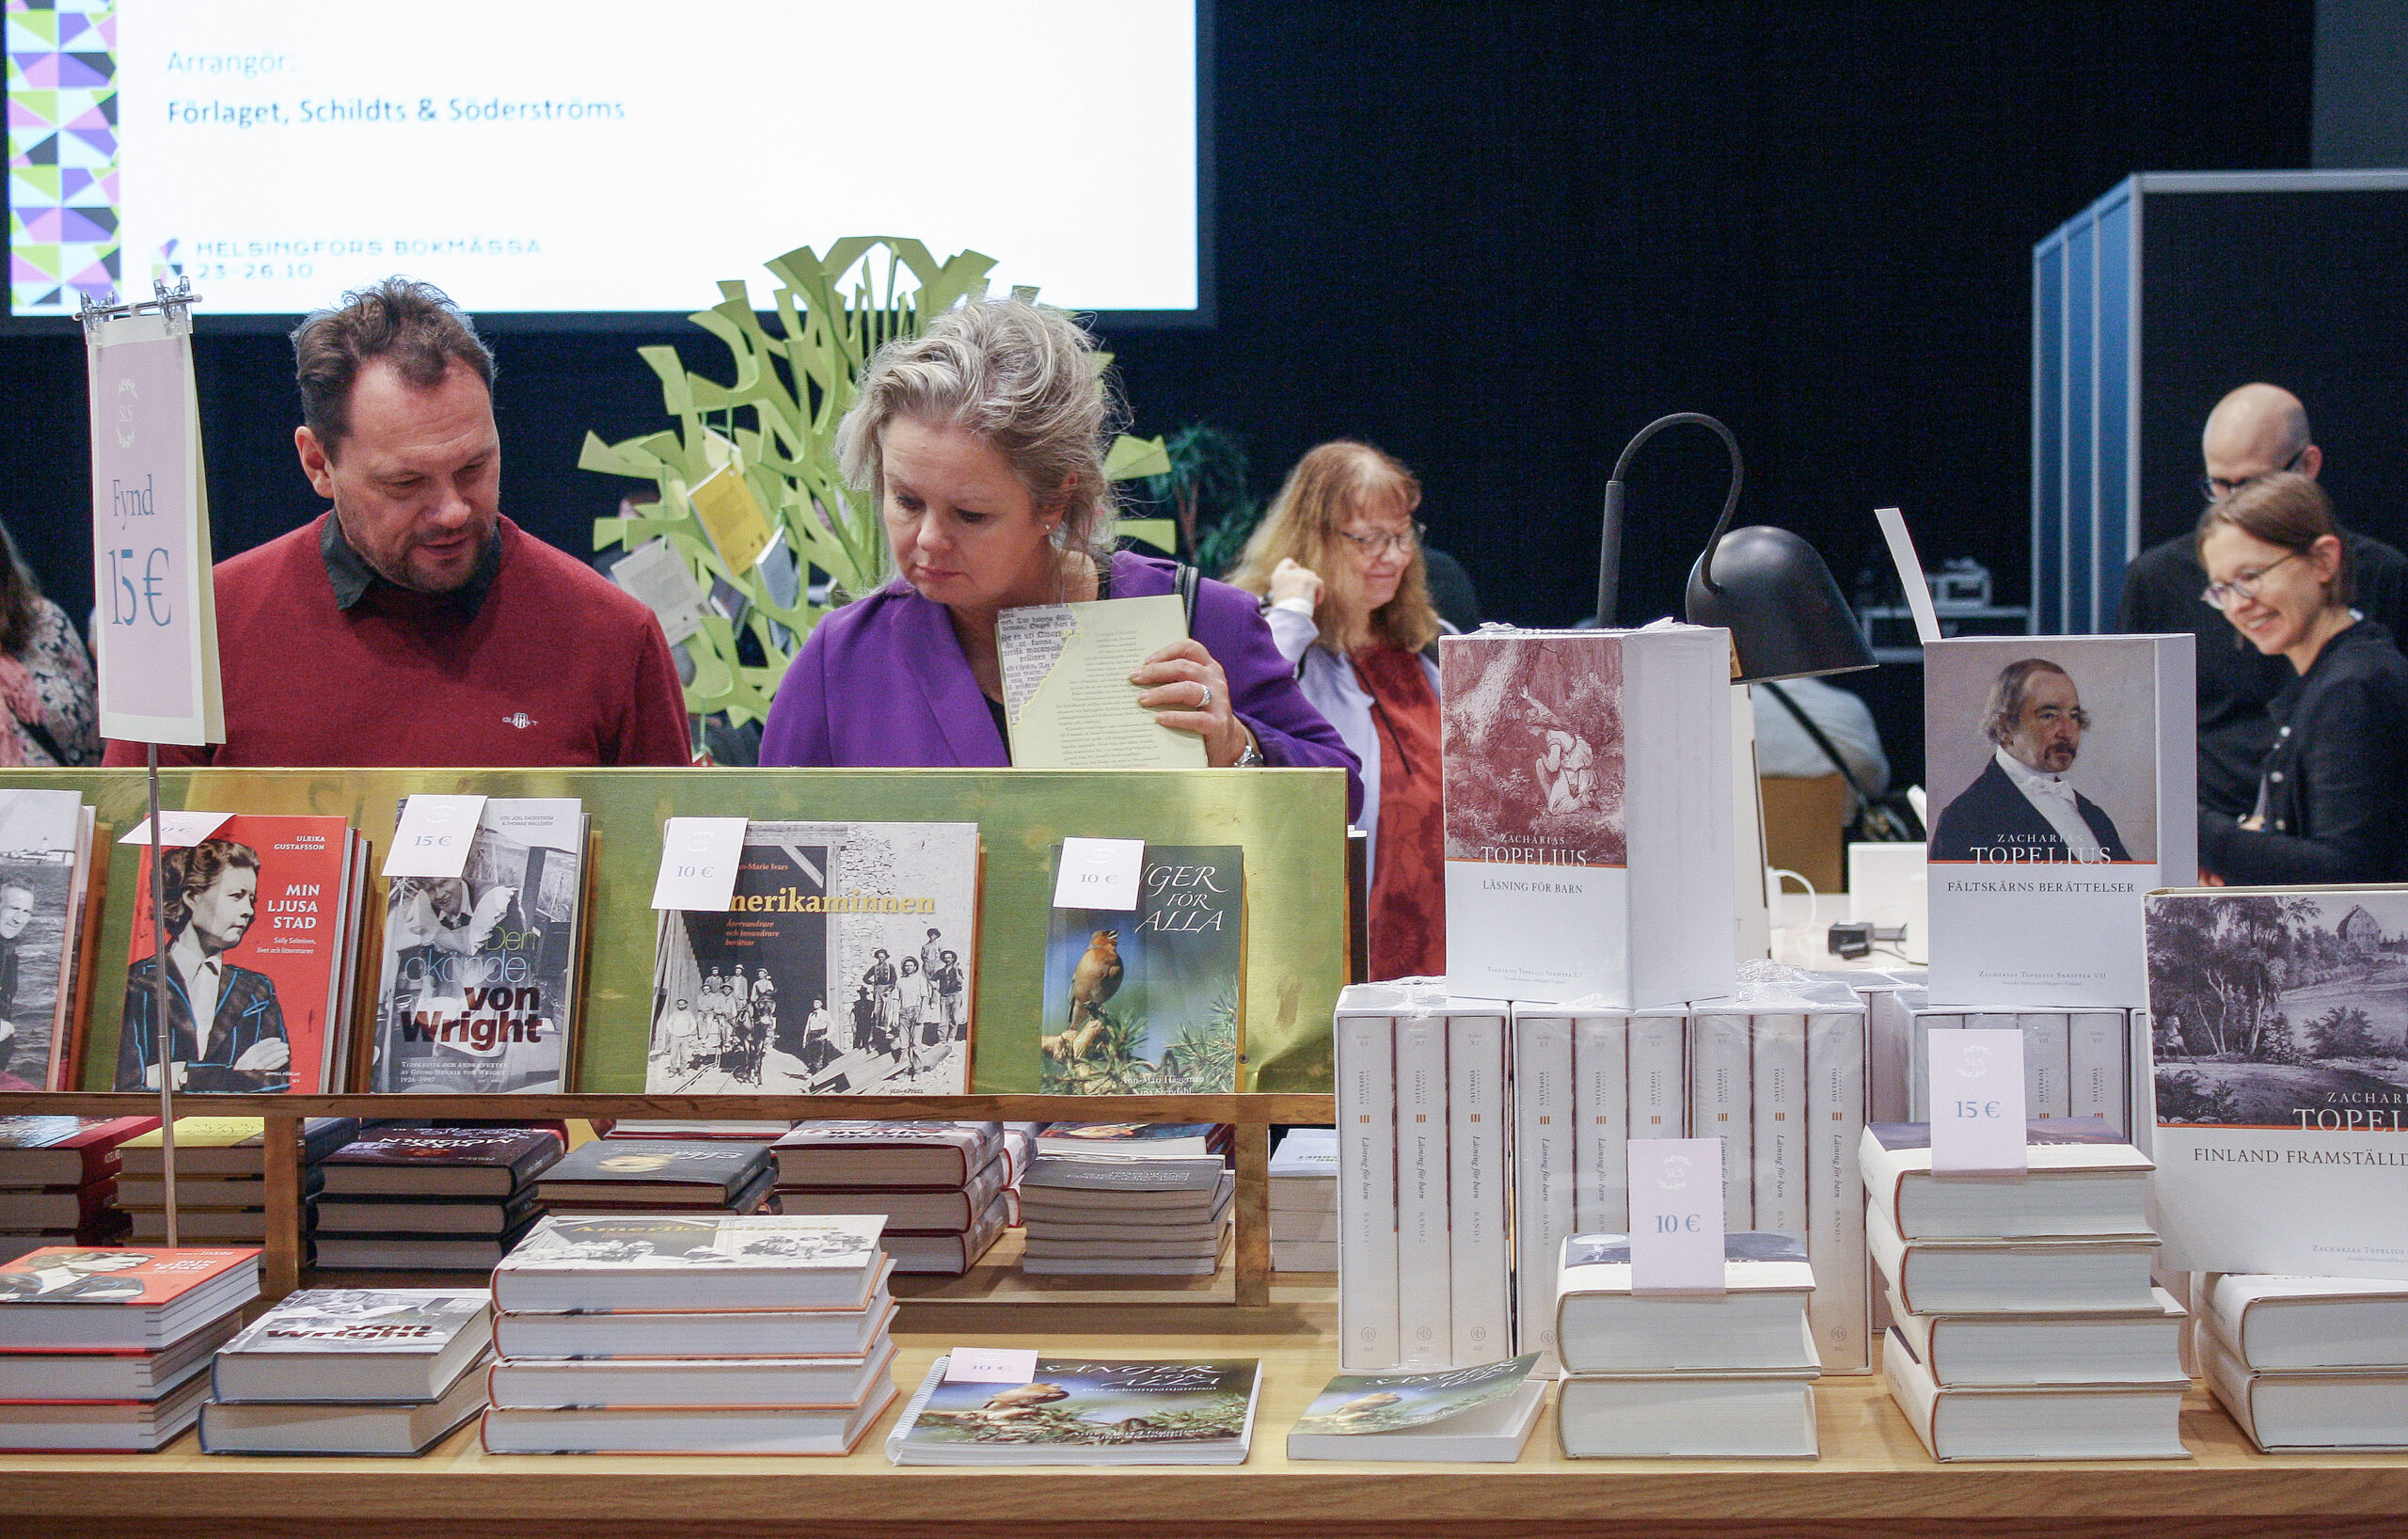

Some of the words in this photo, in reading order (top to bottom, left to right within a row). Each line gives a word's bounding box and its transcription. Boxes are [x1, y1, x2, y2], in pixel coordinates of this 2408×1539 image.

[168, 100, 290, 128] Förlaget,
[300, 99, 406, 122] Schildts
[418, 98, 437, 122] &
[449, 98, 626, 121] Söderströms
[197, 240, 384, 258] HELSINGFORS
[112, 473, 155, 531] Fynd
[414, 835, 435, 847] 15
[1500, 833, 1566, 845] ZACHARIAS
[1997, 833, 2083, 843] ZACHARIAS
[1480, 846, 1588, 867] TOPELIUS
[1969, 846, 2112, 865] TOPELIUS
[676, 865, 696, 878] 10
[701, 865, 715, 878] €
[1081, 874, 1099, 883] 10
[1140, 863, 1228, 896] GER
[286, 884, 320, 896] MIN
[1482, 880, 1529, 892] LÄSNING
[1531, 881, 1551, 893] FÖR
[1555, 884, 1583, 895] BARN
[1947, 880, 2035, 892] FÄLTSKÄRNS
[2038, 881, 2134, 893] BERÄTTELSER
[267, 900, 319, 912] LJUSA
[728, 887, 935, 914] merikaminnen
[1166, 890, 1214, 911] FÖR
[273, 916, 317, 929] STAD
[1135, 911, 1224, 934] ALLA
[485, 926, 536, 951] Den
[464, 987, 541, 1011] von
[400, 1010, 543, 1052] Wright
[1956, 1101, 1977, 1119] 15
[1985, 1101, 2001, 1119] €
[2194, 1148, 2279, 1164] FINLAND
[1655, 1214, 1678, 1234] 10
[1686, 1214, 1701, 1233] €
[266, 1329, 433, 1340] Wright
